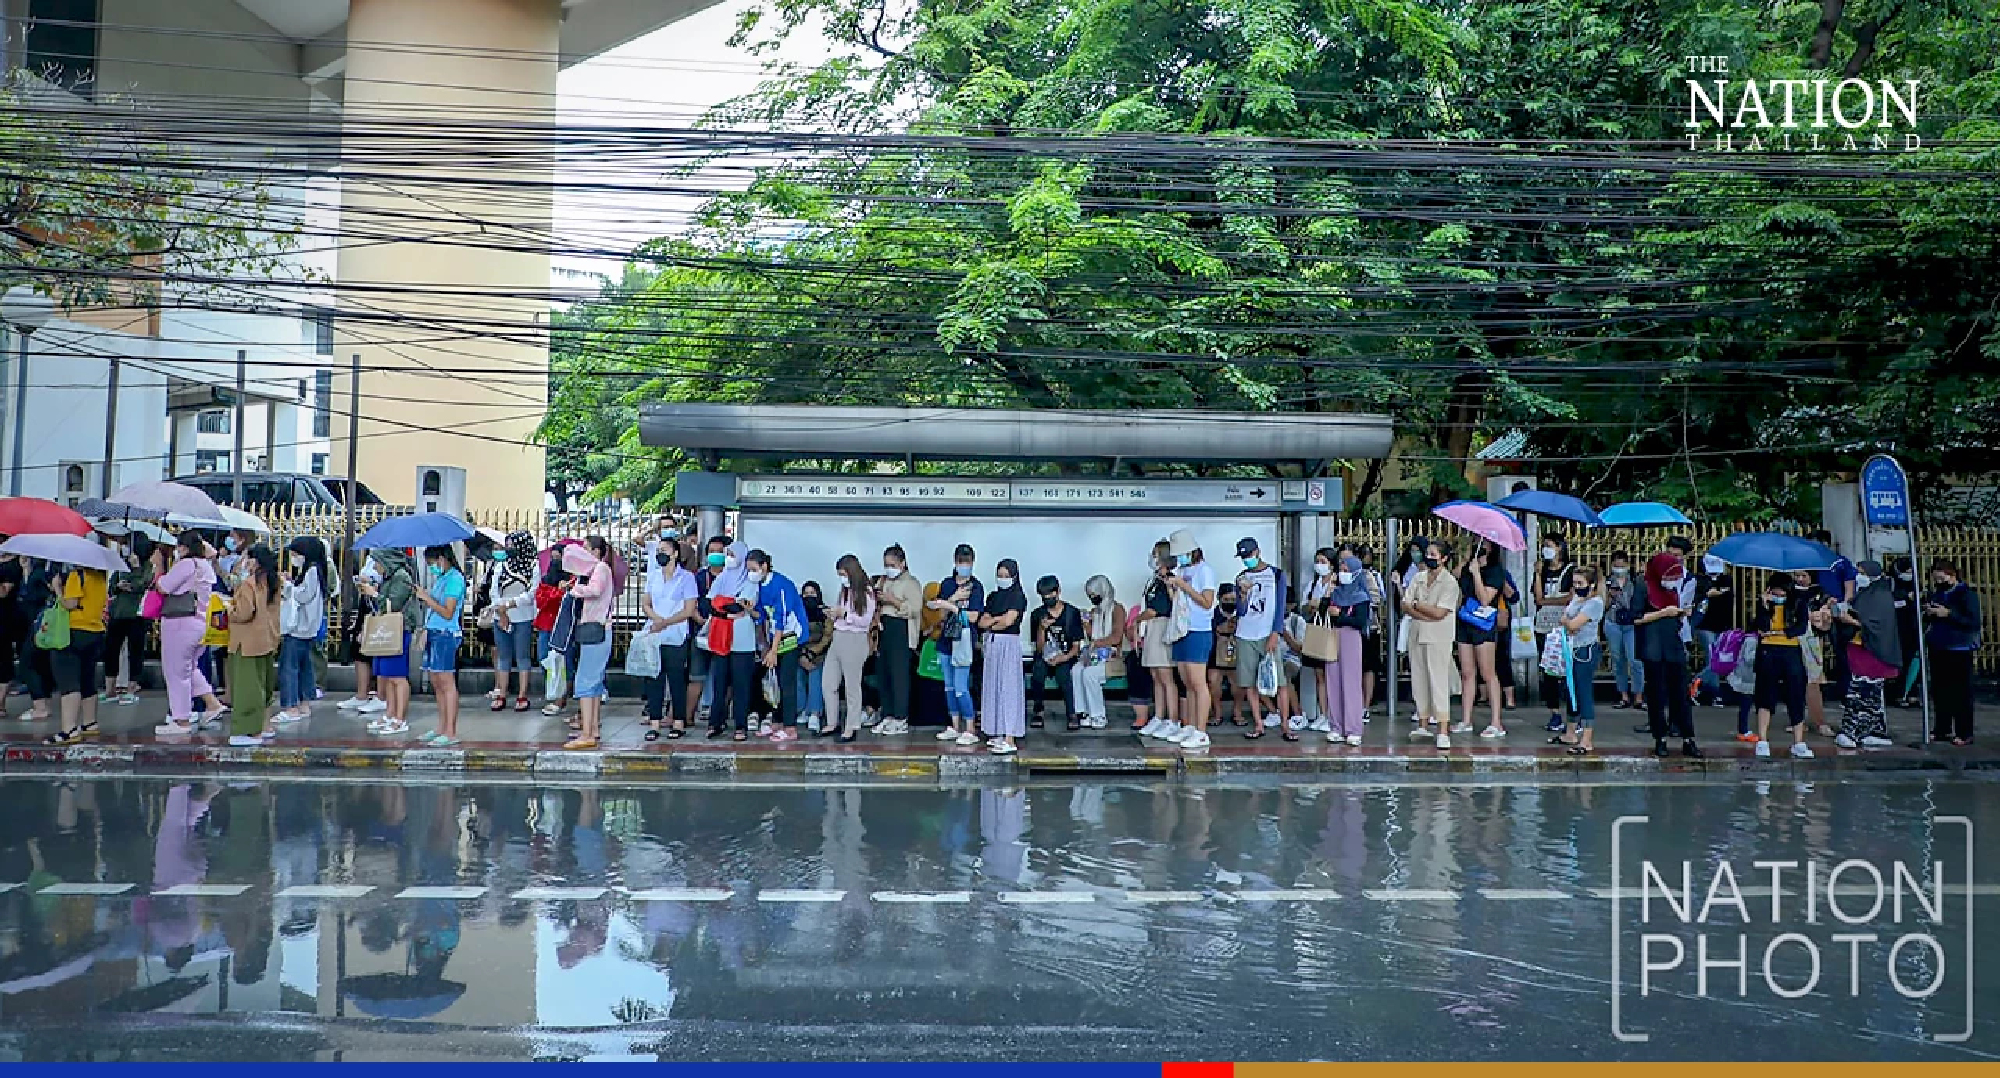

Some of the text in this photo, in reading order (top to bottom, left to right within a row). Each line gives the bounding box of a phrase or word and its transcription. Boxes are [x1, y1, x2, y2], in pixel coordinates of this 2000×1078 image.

[809, 485, 820, 494] 40
[864, 486, 874, 495] 71
[991, 488, 1005, 497] 122
